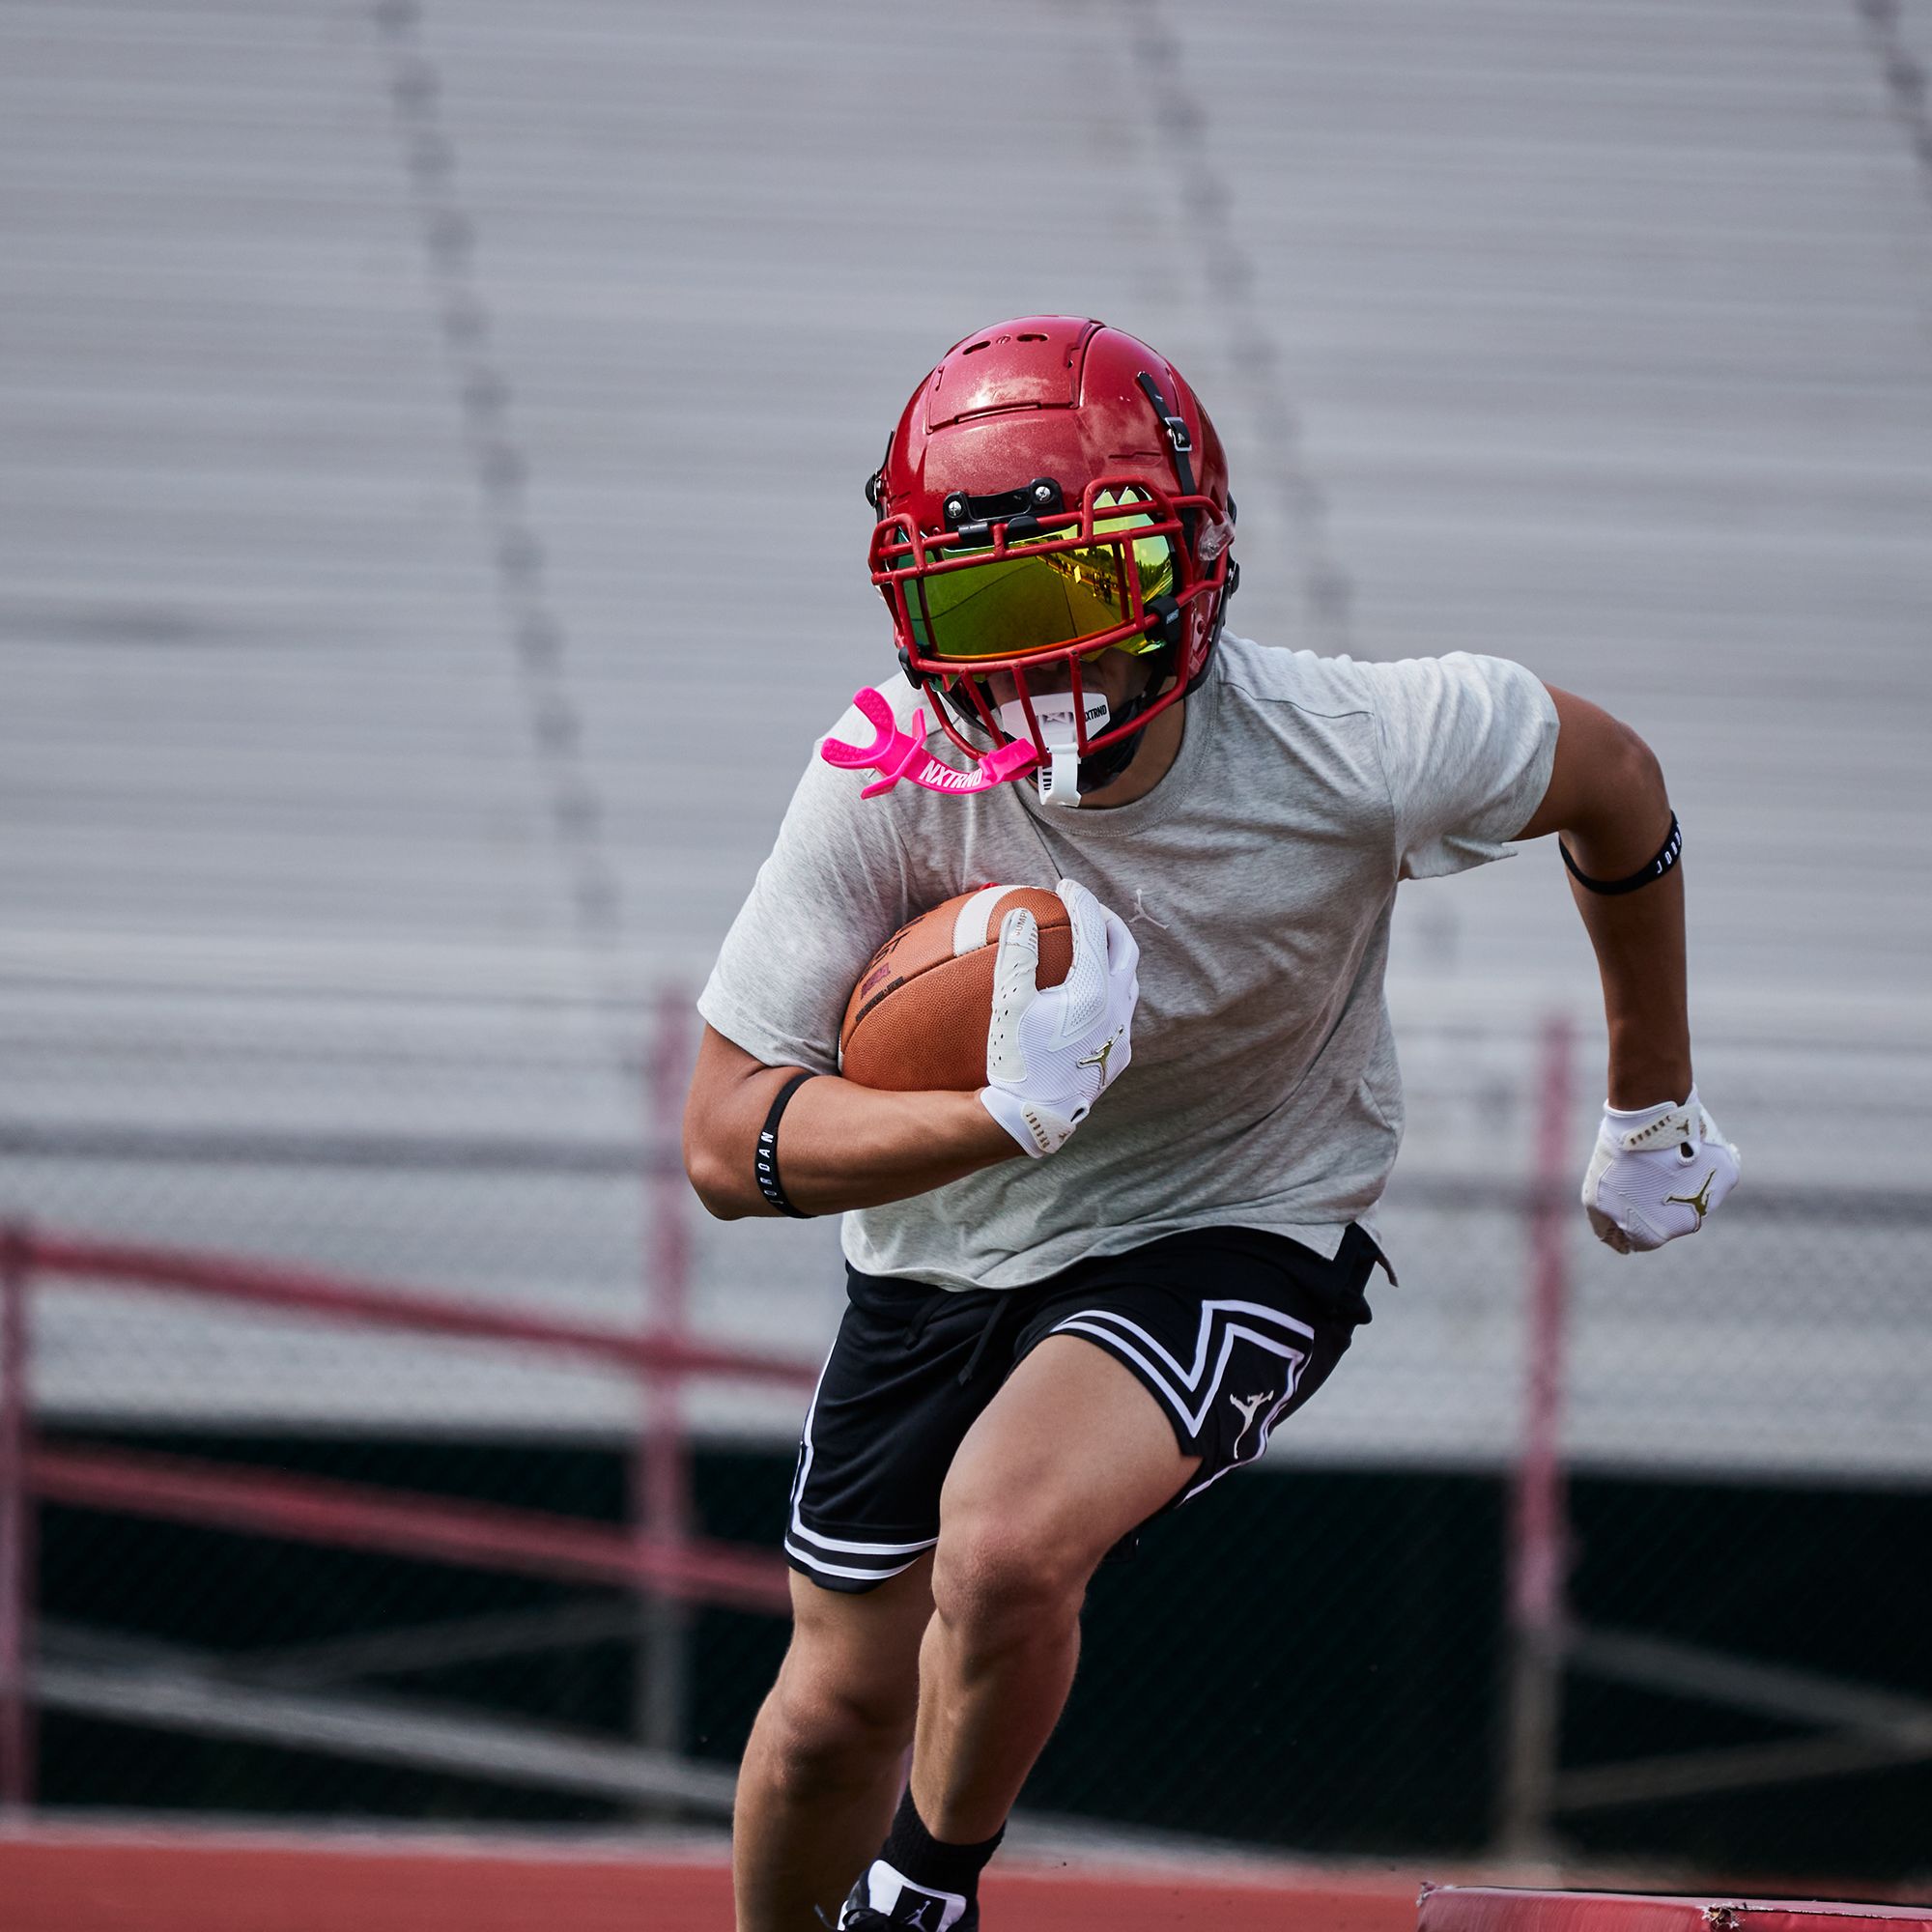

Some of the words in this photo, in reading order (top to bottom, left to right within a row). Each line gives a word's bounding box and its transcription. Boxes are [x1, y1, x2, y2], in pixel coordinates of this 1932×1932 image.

[1085, 704, 1107, 722] XTRND
[919, 759, 982, 788] NXTRND
[757, 1131, 783, 1205] JORDAN
